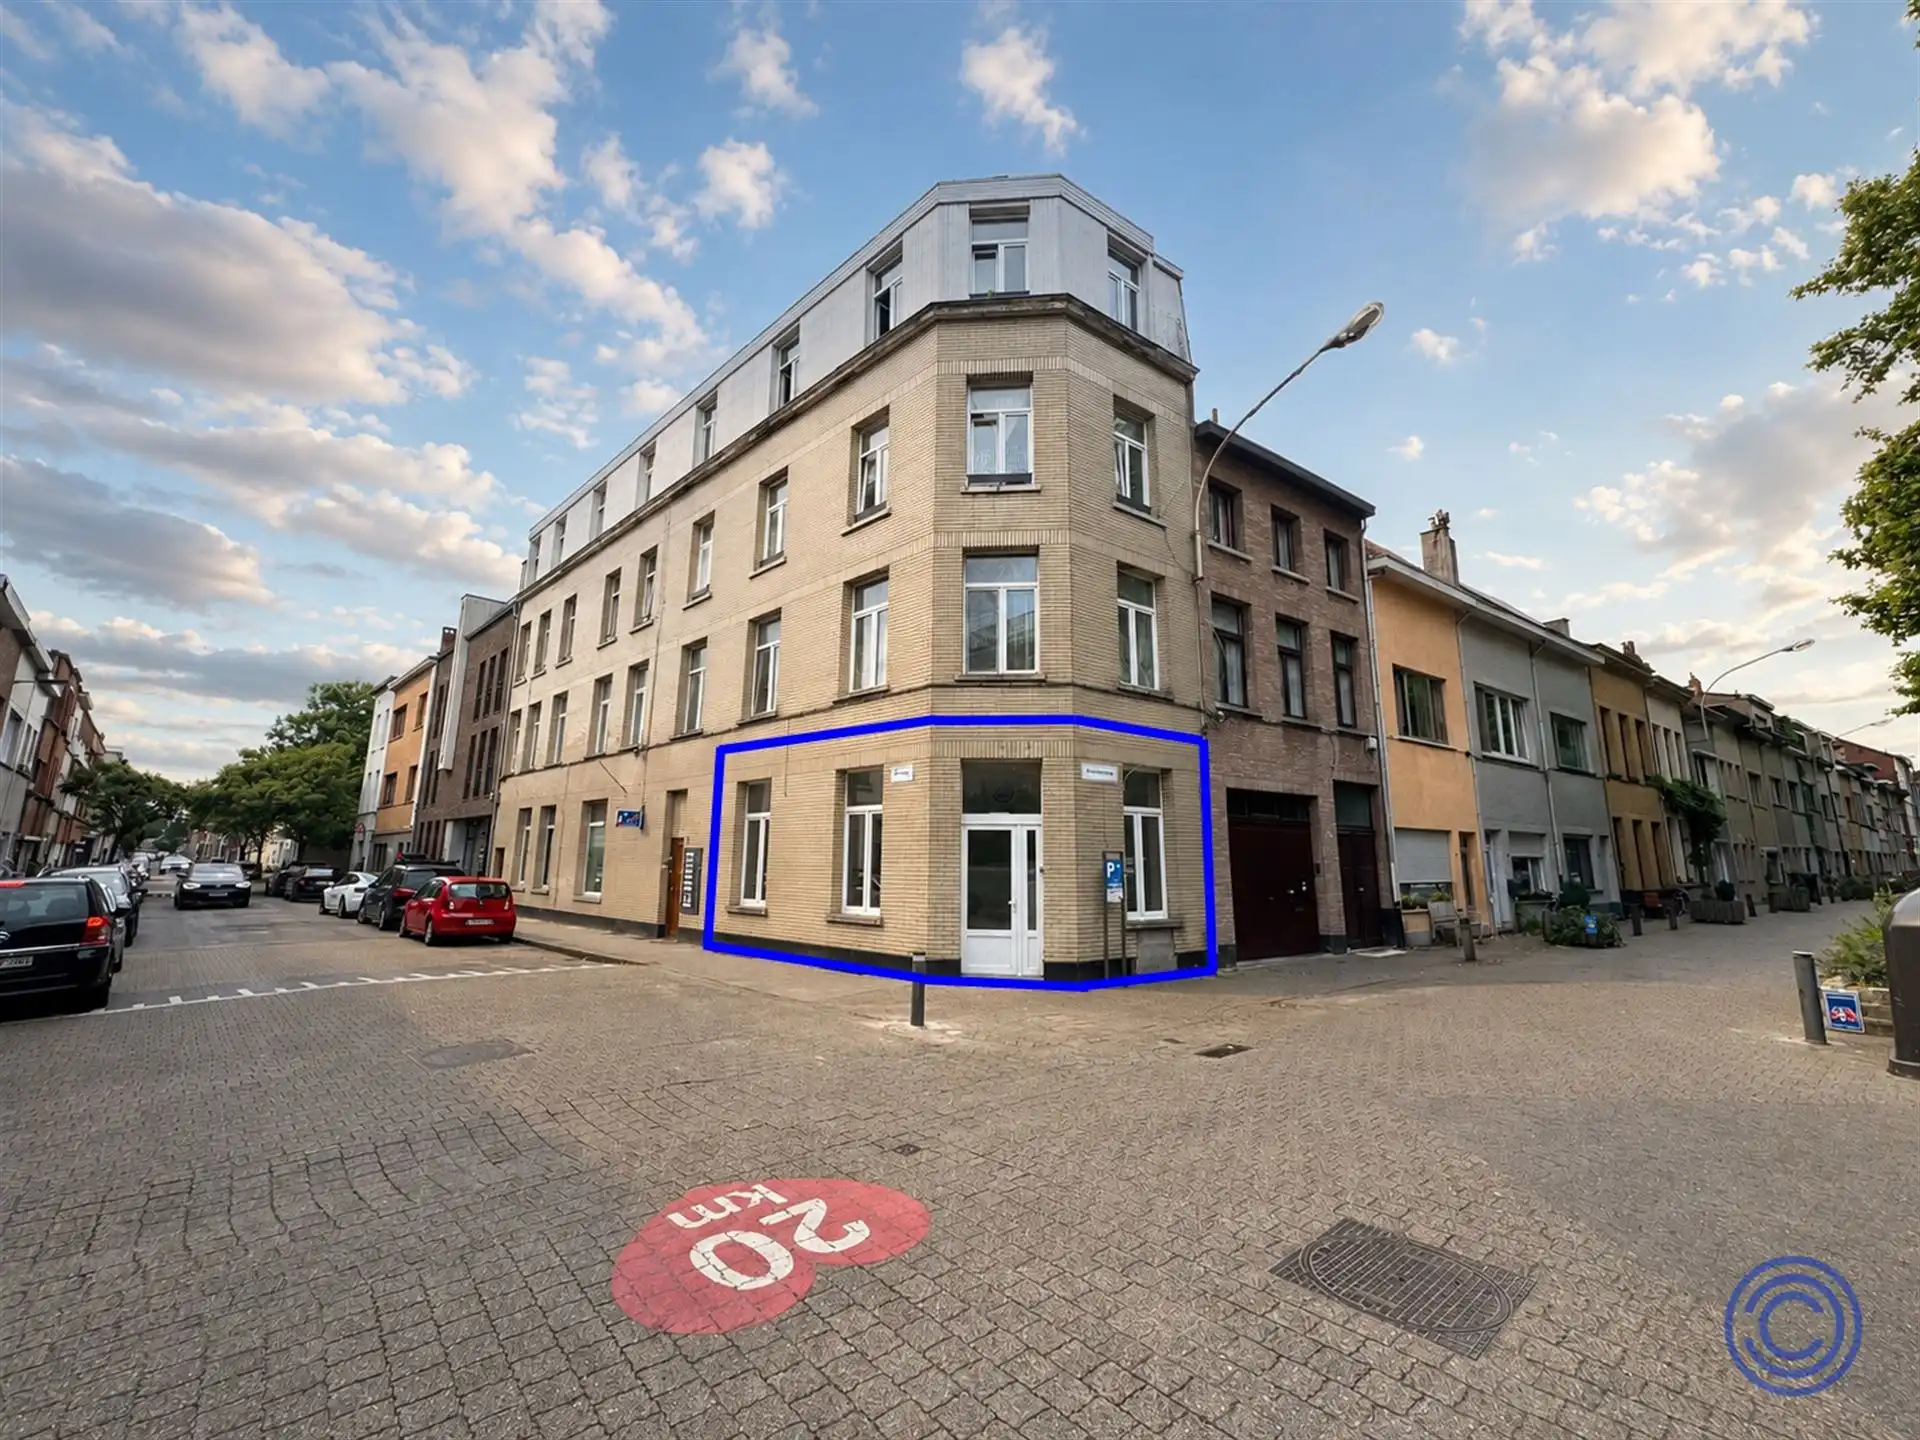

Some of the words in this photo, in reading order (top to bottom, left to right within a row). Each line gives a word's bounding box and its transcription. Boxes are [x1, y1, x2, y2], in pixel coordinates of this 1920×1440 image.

[1106, 861, 1115, 878] P
[667, 1184, 788, 1229] km
[689, 1197, 871, 1291] 20
